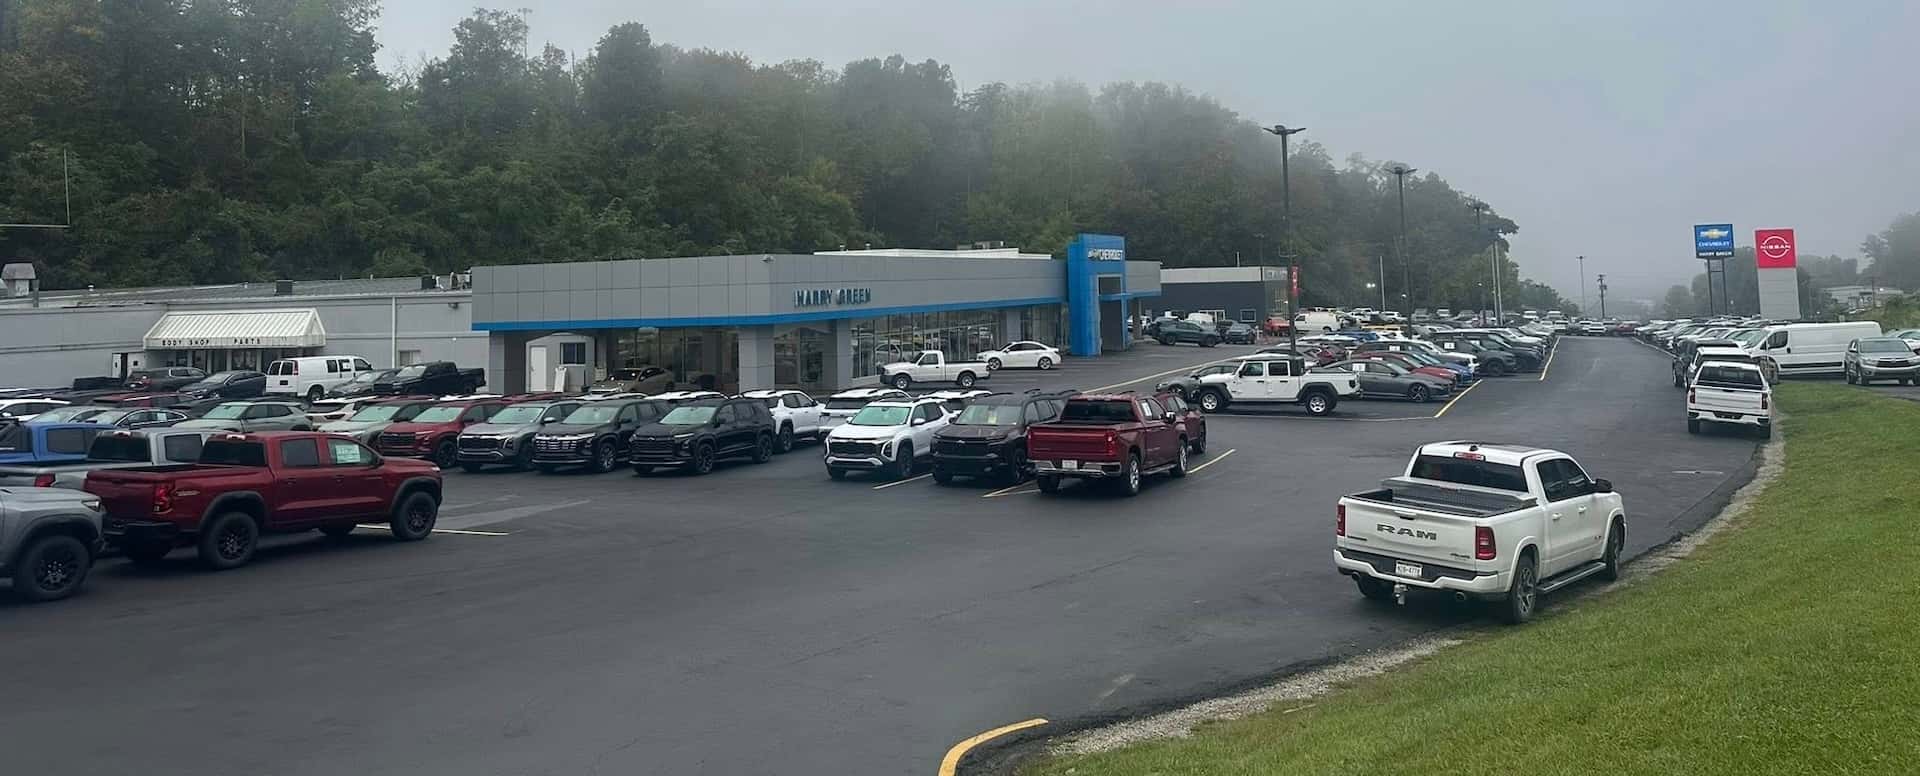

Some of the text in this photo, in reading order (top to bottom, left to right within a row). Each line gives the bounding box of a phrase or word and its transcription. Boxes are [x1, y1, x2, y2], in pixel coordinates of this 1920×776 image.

[793, 287, 871, 308] HARRY GREEN
[1376, 523, 1437, 541] RAM
